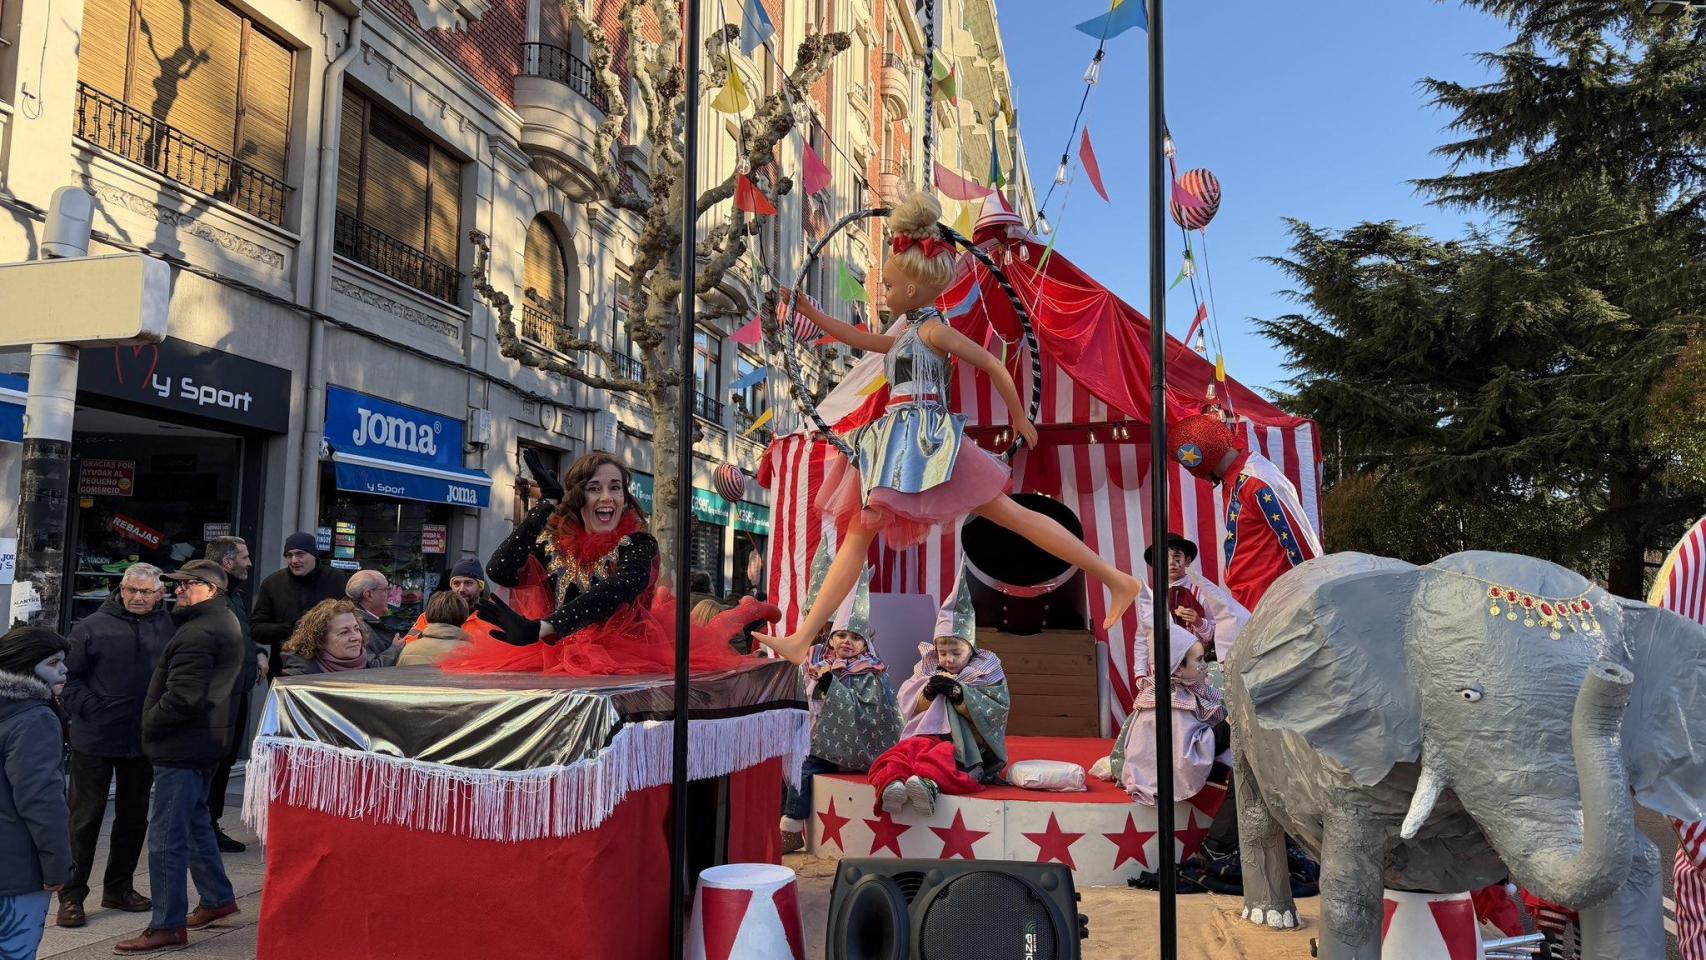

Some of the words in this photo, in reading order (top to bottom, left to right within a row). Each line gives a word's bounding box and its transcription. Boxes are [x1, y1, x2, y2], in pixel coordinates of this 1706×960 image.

[180, 376, 252, 411] Sport
[117, 461, 134, 469] POR
[81, 469, 112, 477] AYUDAR
[80, 486, 120, 494] COMERCIO
[377, 483, 405, 495] Sport
[112, 516, 160, 545] REBAJAS
